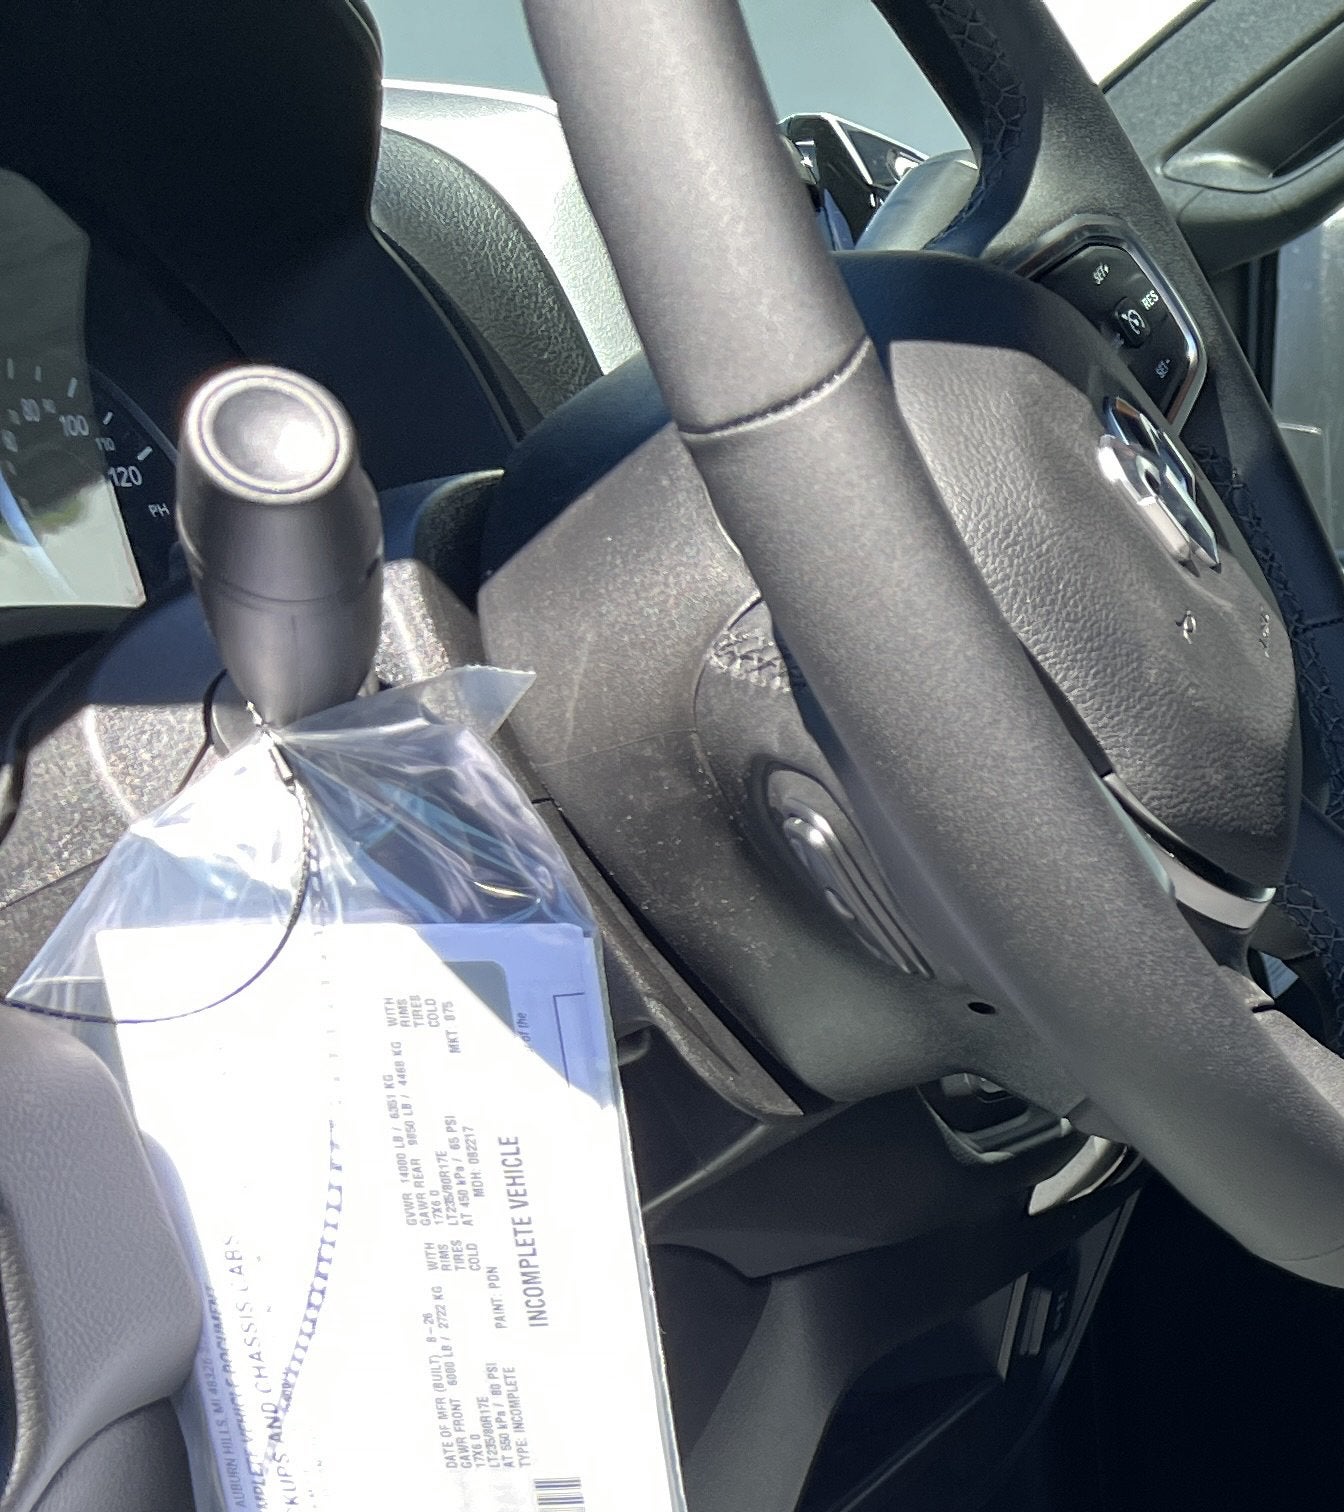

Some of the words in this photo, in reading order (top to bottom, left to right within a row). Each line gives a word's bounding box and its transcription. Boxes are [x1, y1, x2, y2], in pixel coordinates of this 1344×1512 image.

[1140, 289, 1159, 310] RES
[59, 414, 90, 437] 100
[107, 465, 143, 488] 120
[383, 996, 401, 1026] WITH
[423, 997, 440, 1027] COLD
[444, 1114, 457, 1132] PSI
[497, 1135, 529, 1209] VEHICLE
[459, 1211, 473, 1226] AT
[423, 1241, 439, 1270] WITH
[465, 1241, 481, 1271] COLD
[510, 1215, 548, 1327] INCOMPLETE
[485, 1361, 499, 1379] PSI
[501, 1365, 525, 1432] INCOMPLETE
[441, 1440, 458, 1468] DATE
[500, 1453, 515, 1467] AT
